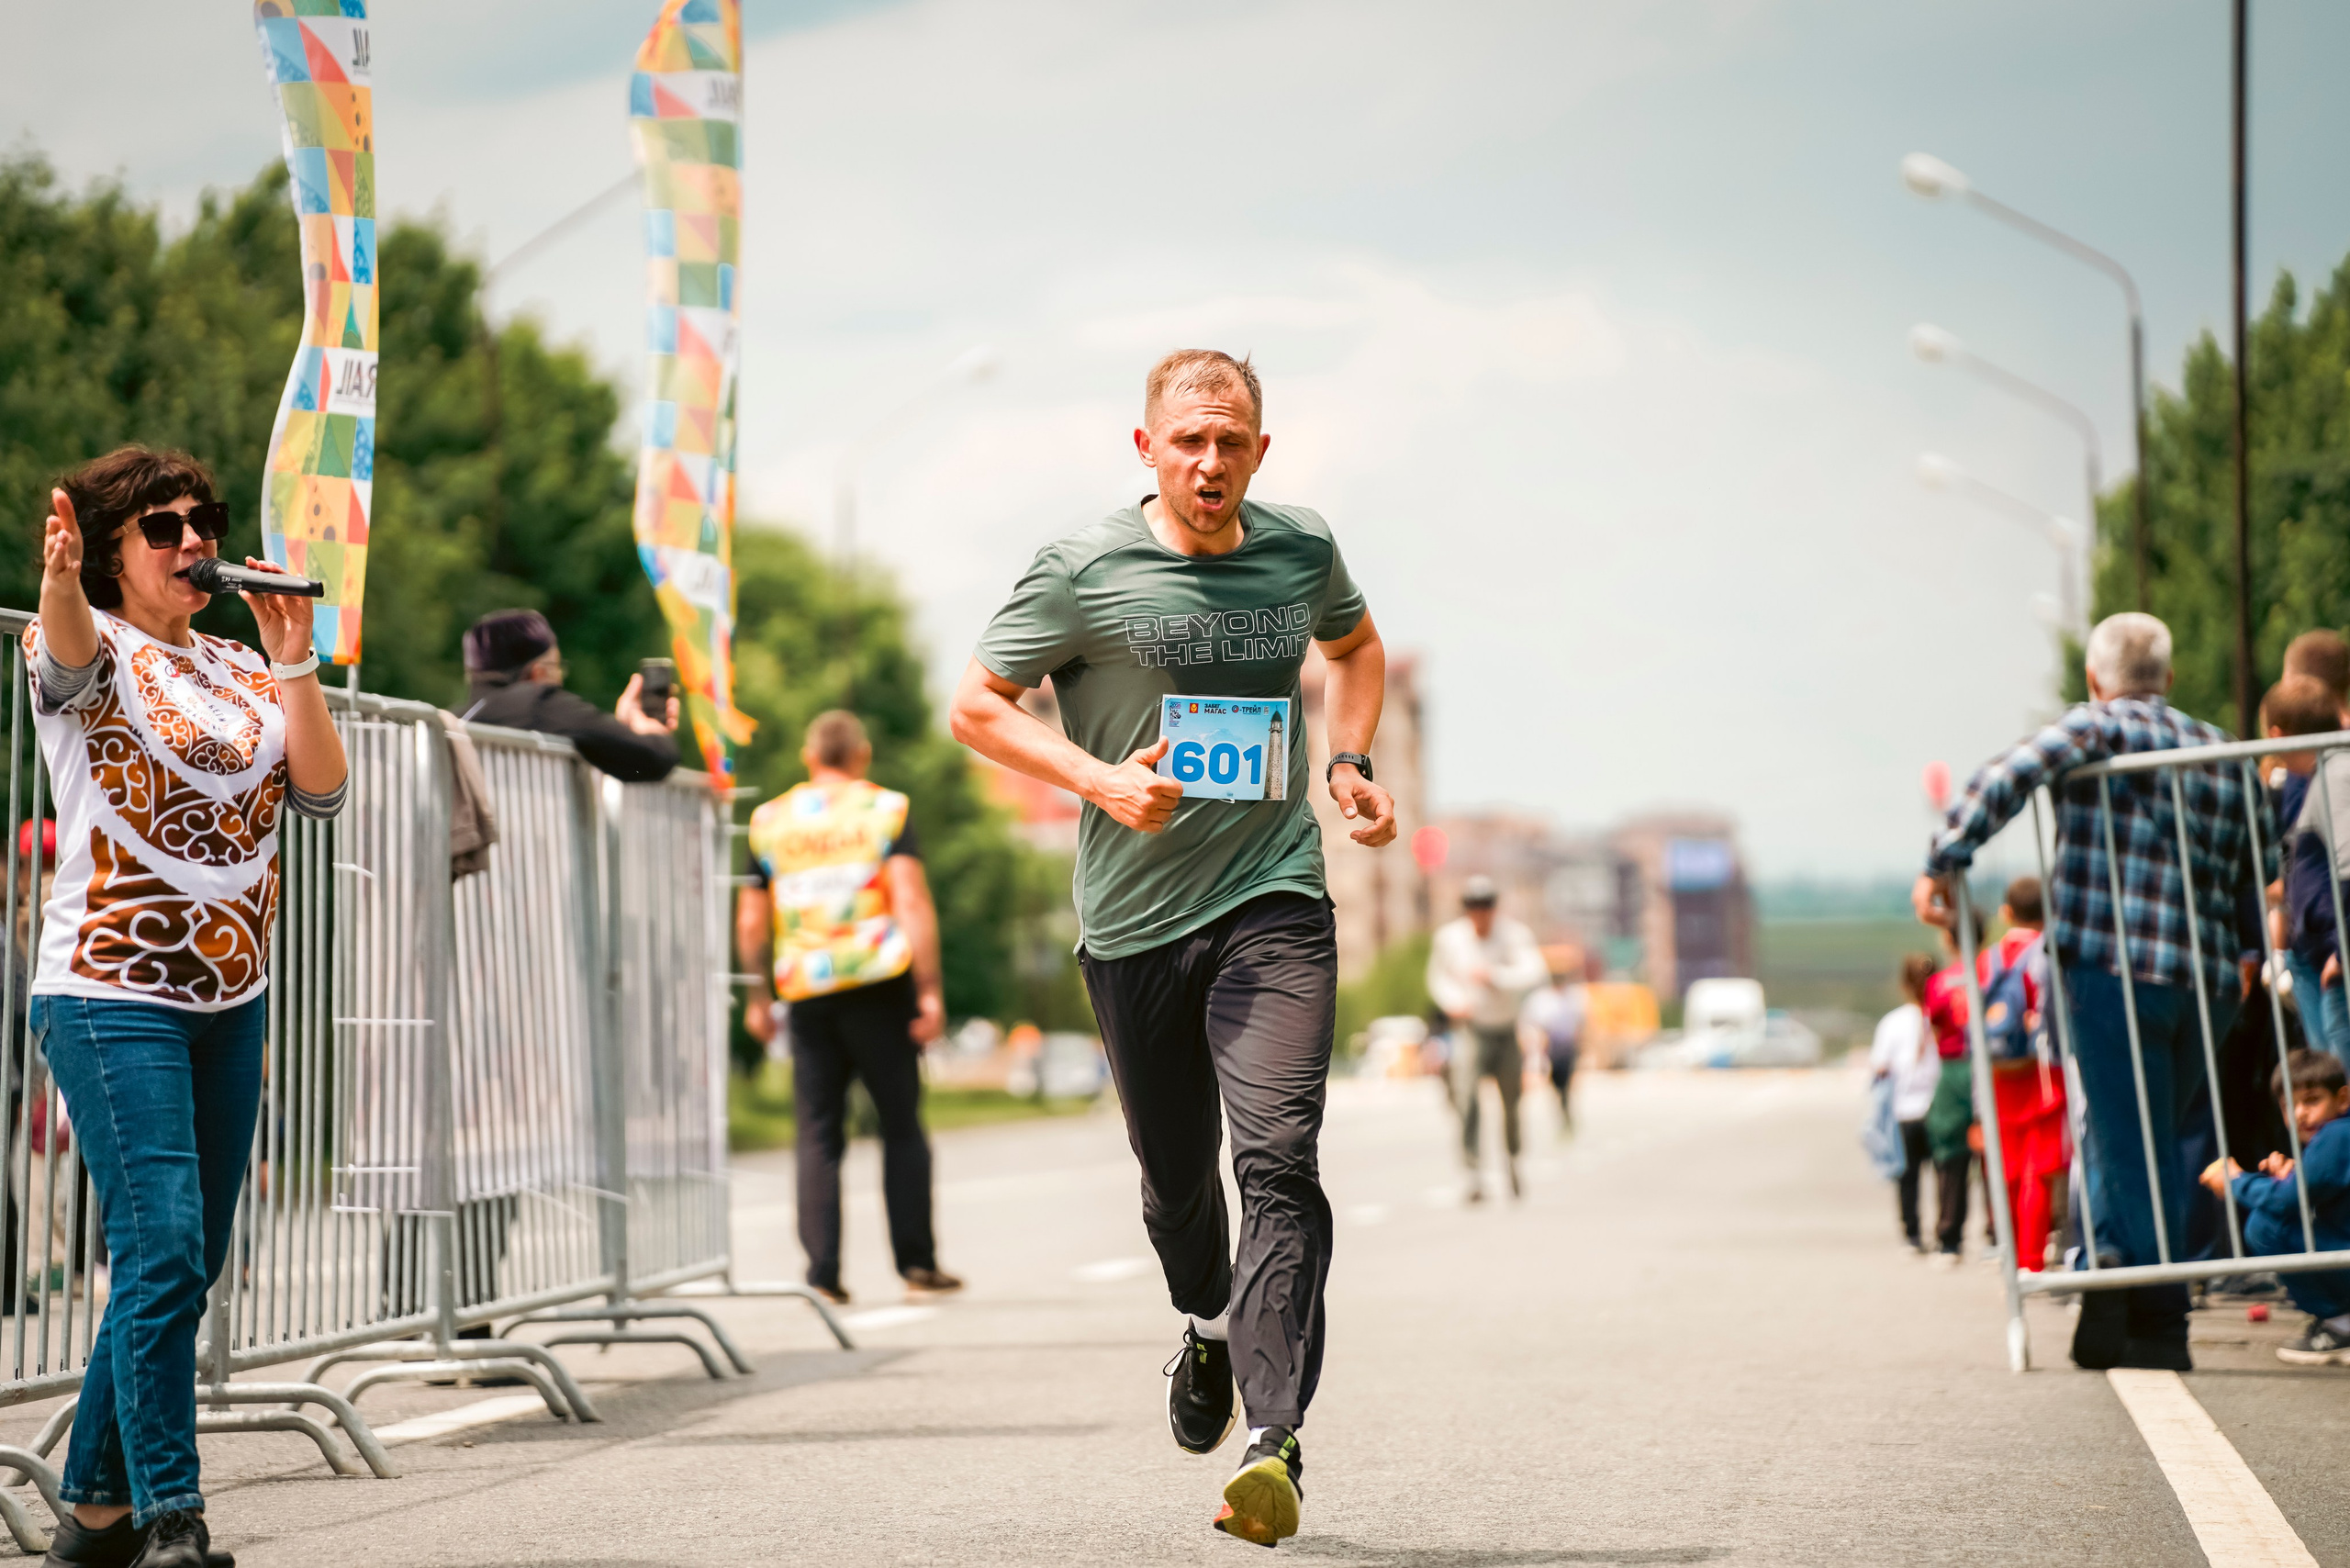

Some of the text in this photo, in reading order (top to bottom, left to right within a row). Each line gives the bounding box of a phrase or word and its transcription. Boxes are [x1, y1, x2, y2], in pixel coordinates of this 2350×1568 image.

[1125, 603, 1311, 643] BEYOND
[1129, 631, 1311, 666] THE LIMIT
[1171, 741, 1263, 785] 601
